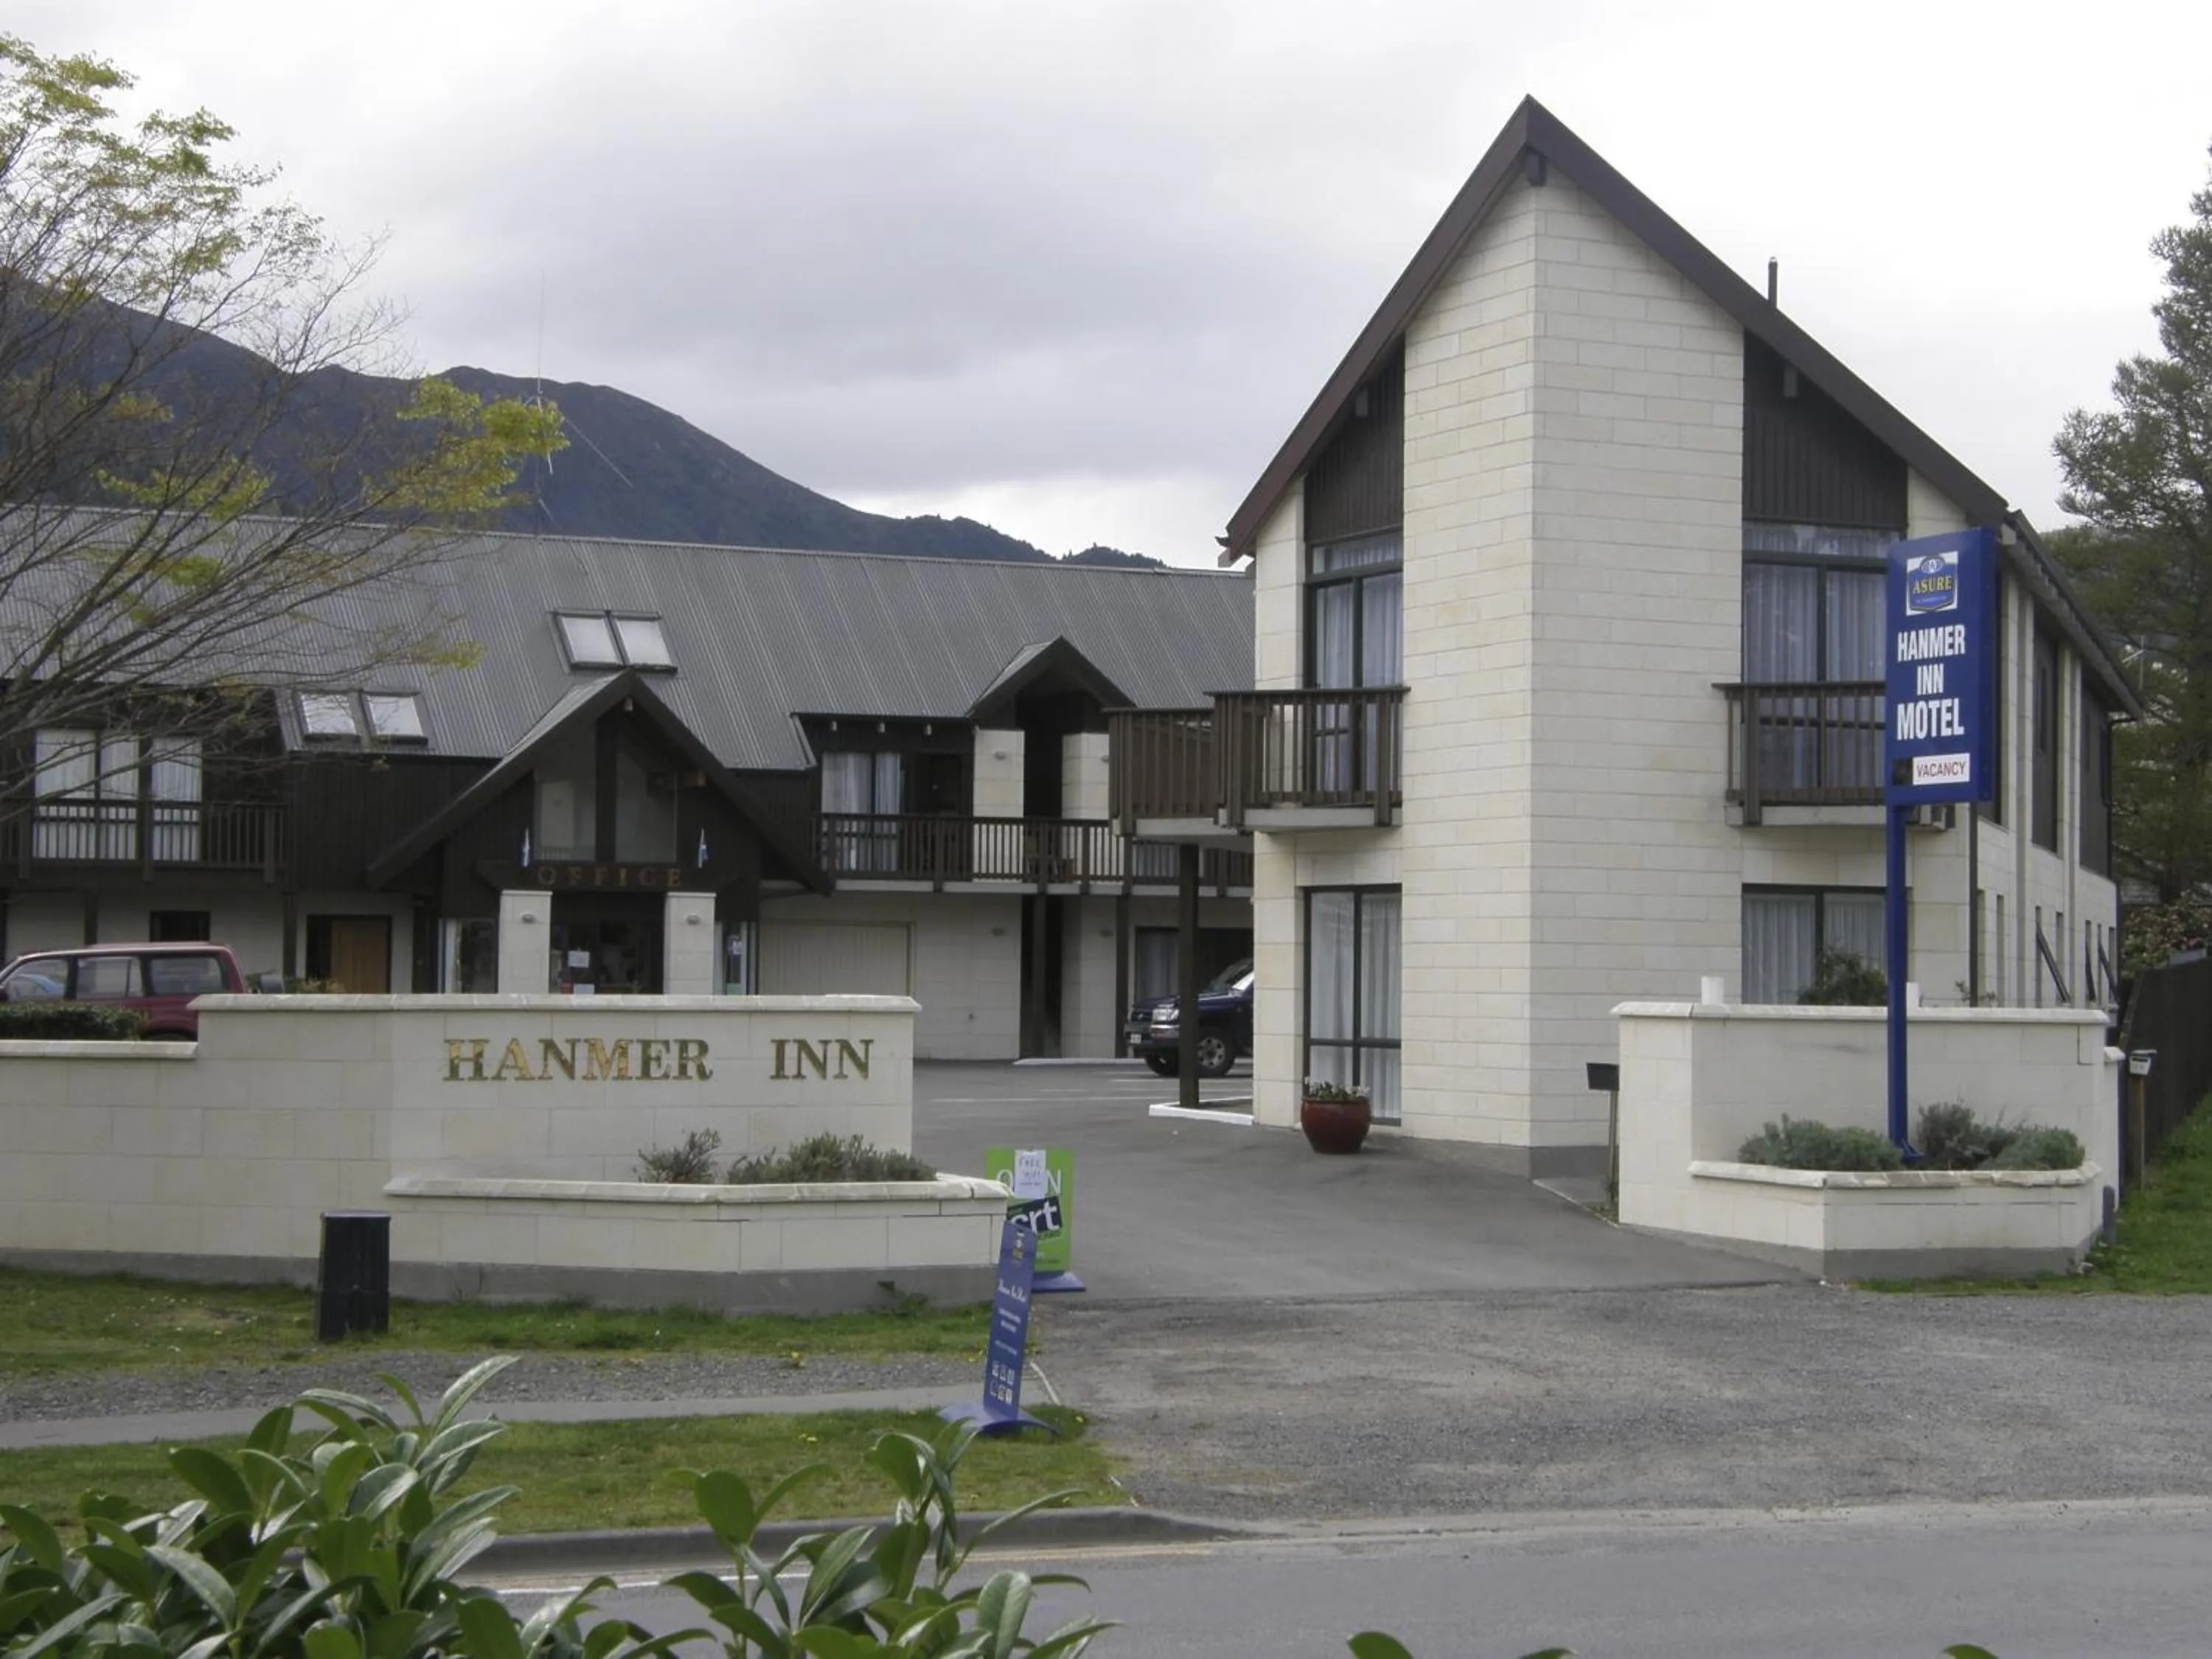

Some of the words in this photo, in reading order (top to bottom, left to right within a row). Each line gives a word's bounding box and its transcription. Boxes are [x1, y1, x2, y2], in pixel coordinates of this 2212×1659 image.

[1912, 576, 1952, 594] ASURE
[1897, 625, 1965, 662] HANMER
[1917, 664, 1944, 695] INN
[1897, 698, 1964, 740] MOTEL
[1916, 760, 1966, 779] VACANCY
[538, 866, 682, 887] OFFICE
[442, 1037, 714, 1082] HANMER
[770, 1038, 874, 1081] INN
[995, 1169, 1062, 1196] ON
